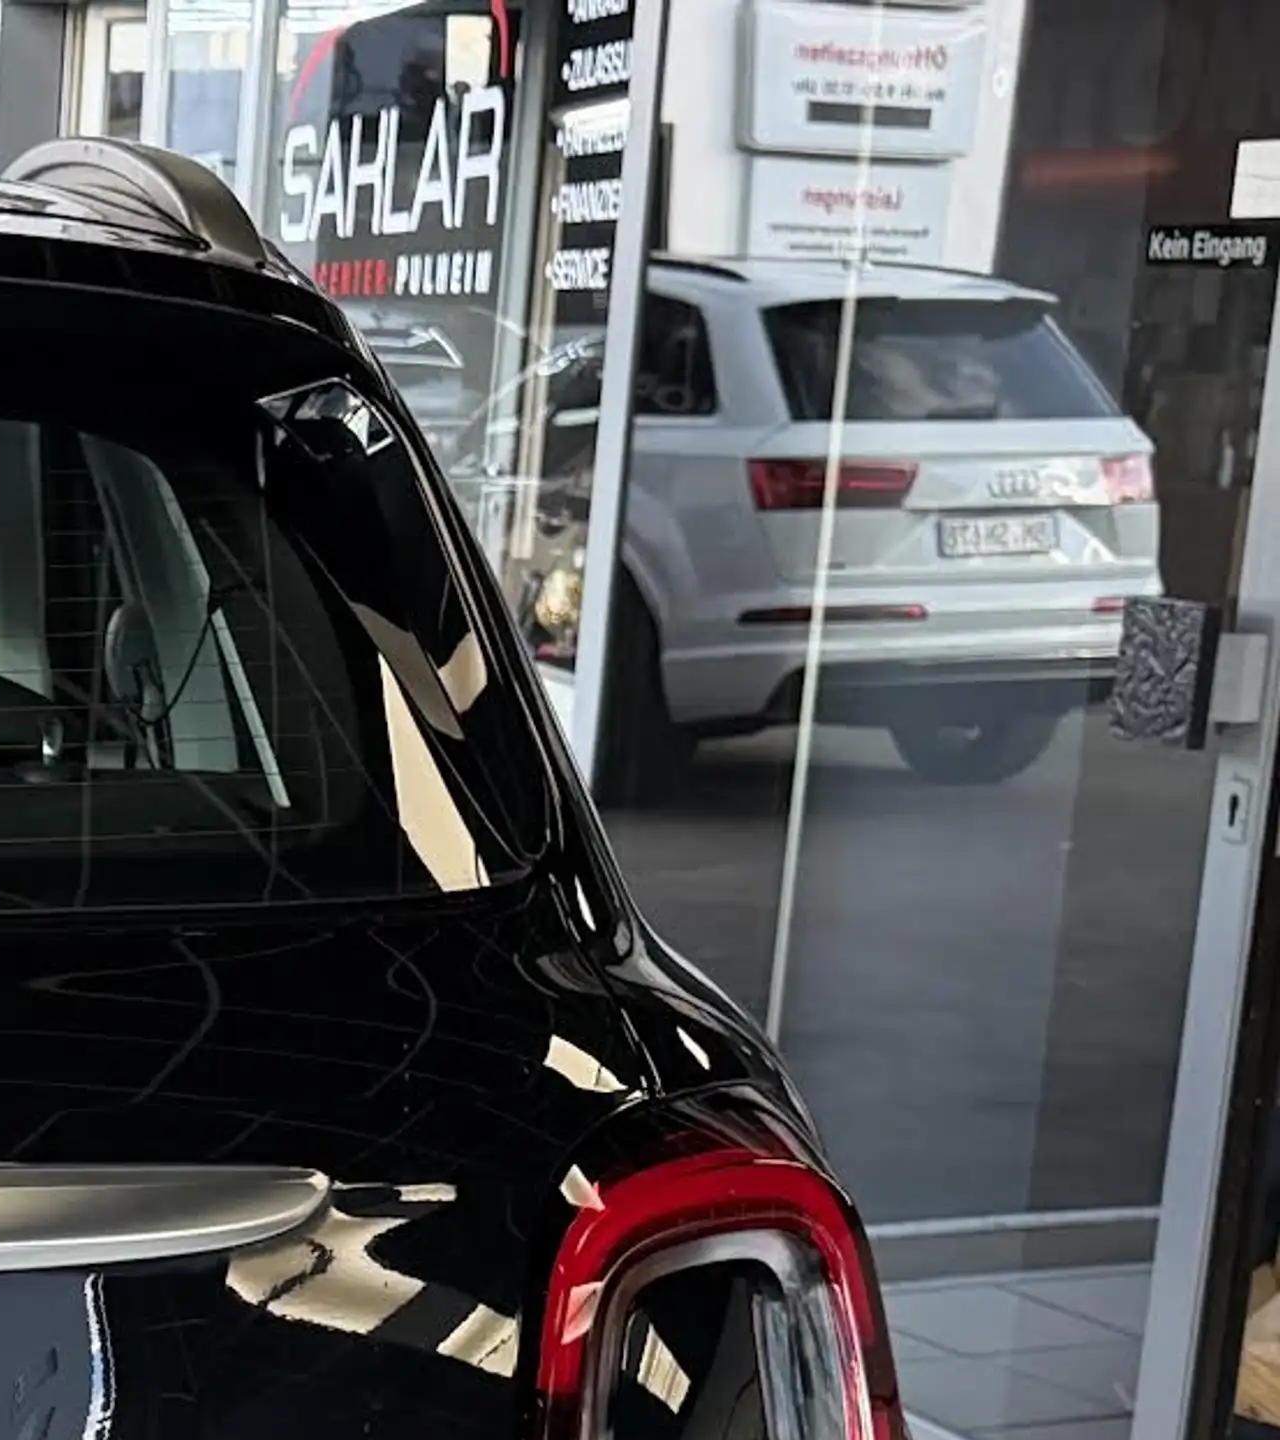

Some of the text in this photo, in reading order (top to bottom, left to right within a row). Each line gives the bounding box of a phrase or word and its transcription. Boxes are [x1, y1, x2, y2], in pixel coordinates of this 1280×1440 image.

[281, 84, 505, 242] SAHLAR
[1148, 229, 1268, 267] Kein Eingang
